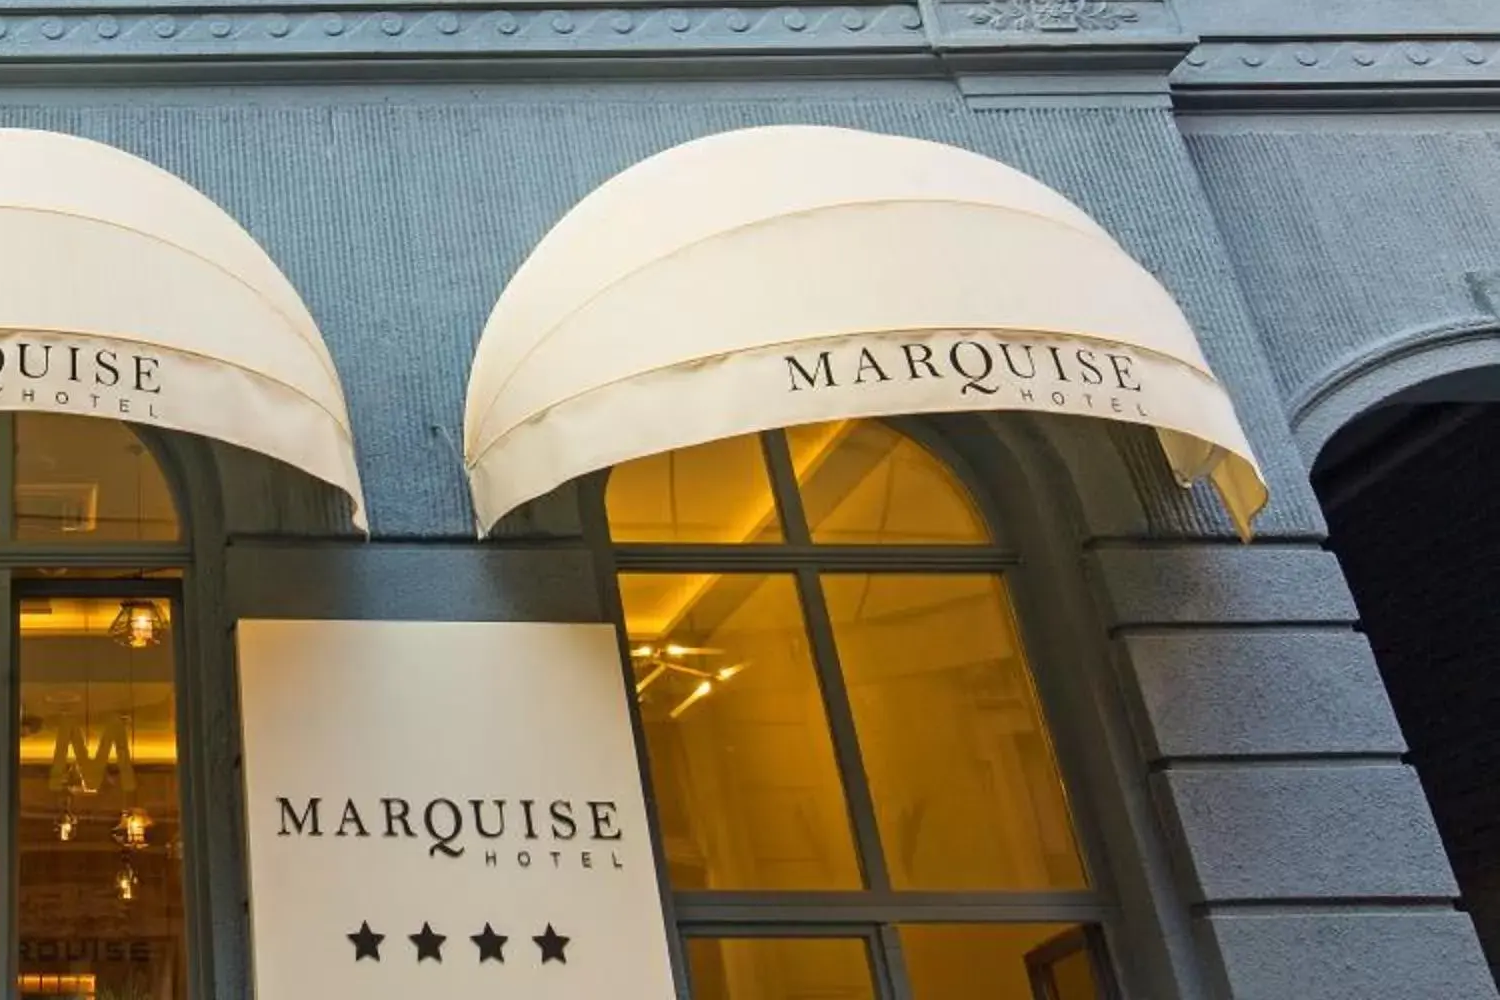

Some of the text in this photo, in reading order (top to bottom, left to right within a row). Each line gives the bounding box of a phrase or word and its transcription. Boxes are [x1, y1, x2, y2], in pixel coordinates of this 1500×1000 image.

[784, 341, 1142, 395] MARQUISE
[22, 388, 160, 418] HOTEL
[1020, 387, 1149, 417] HOTEL
[276, 797, 622, 858] MARQUISE
[485, 851, 623, 868] HOTEL
